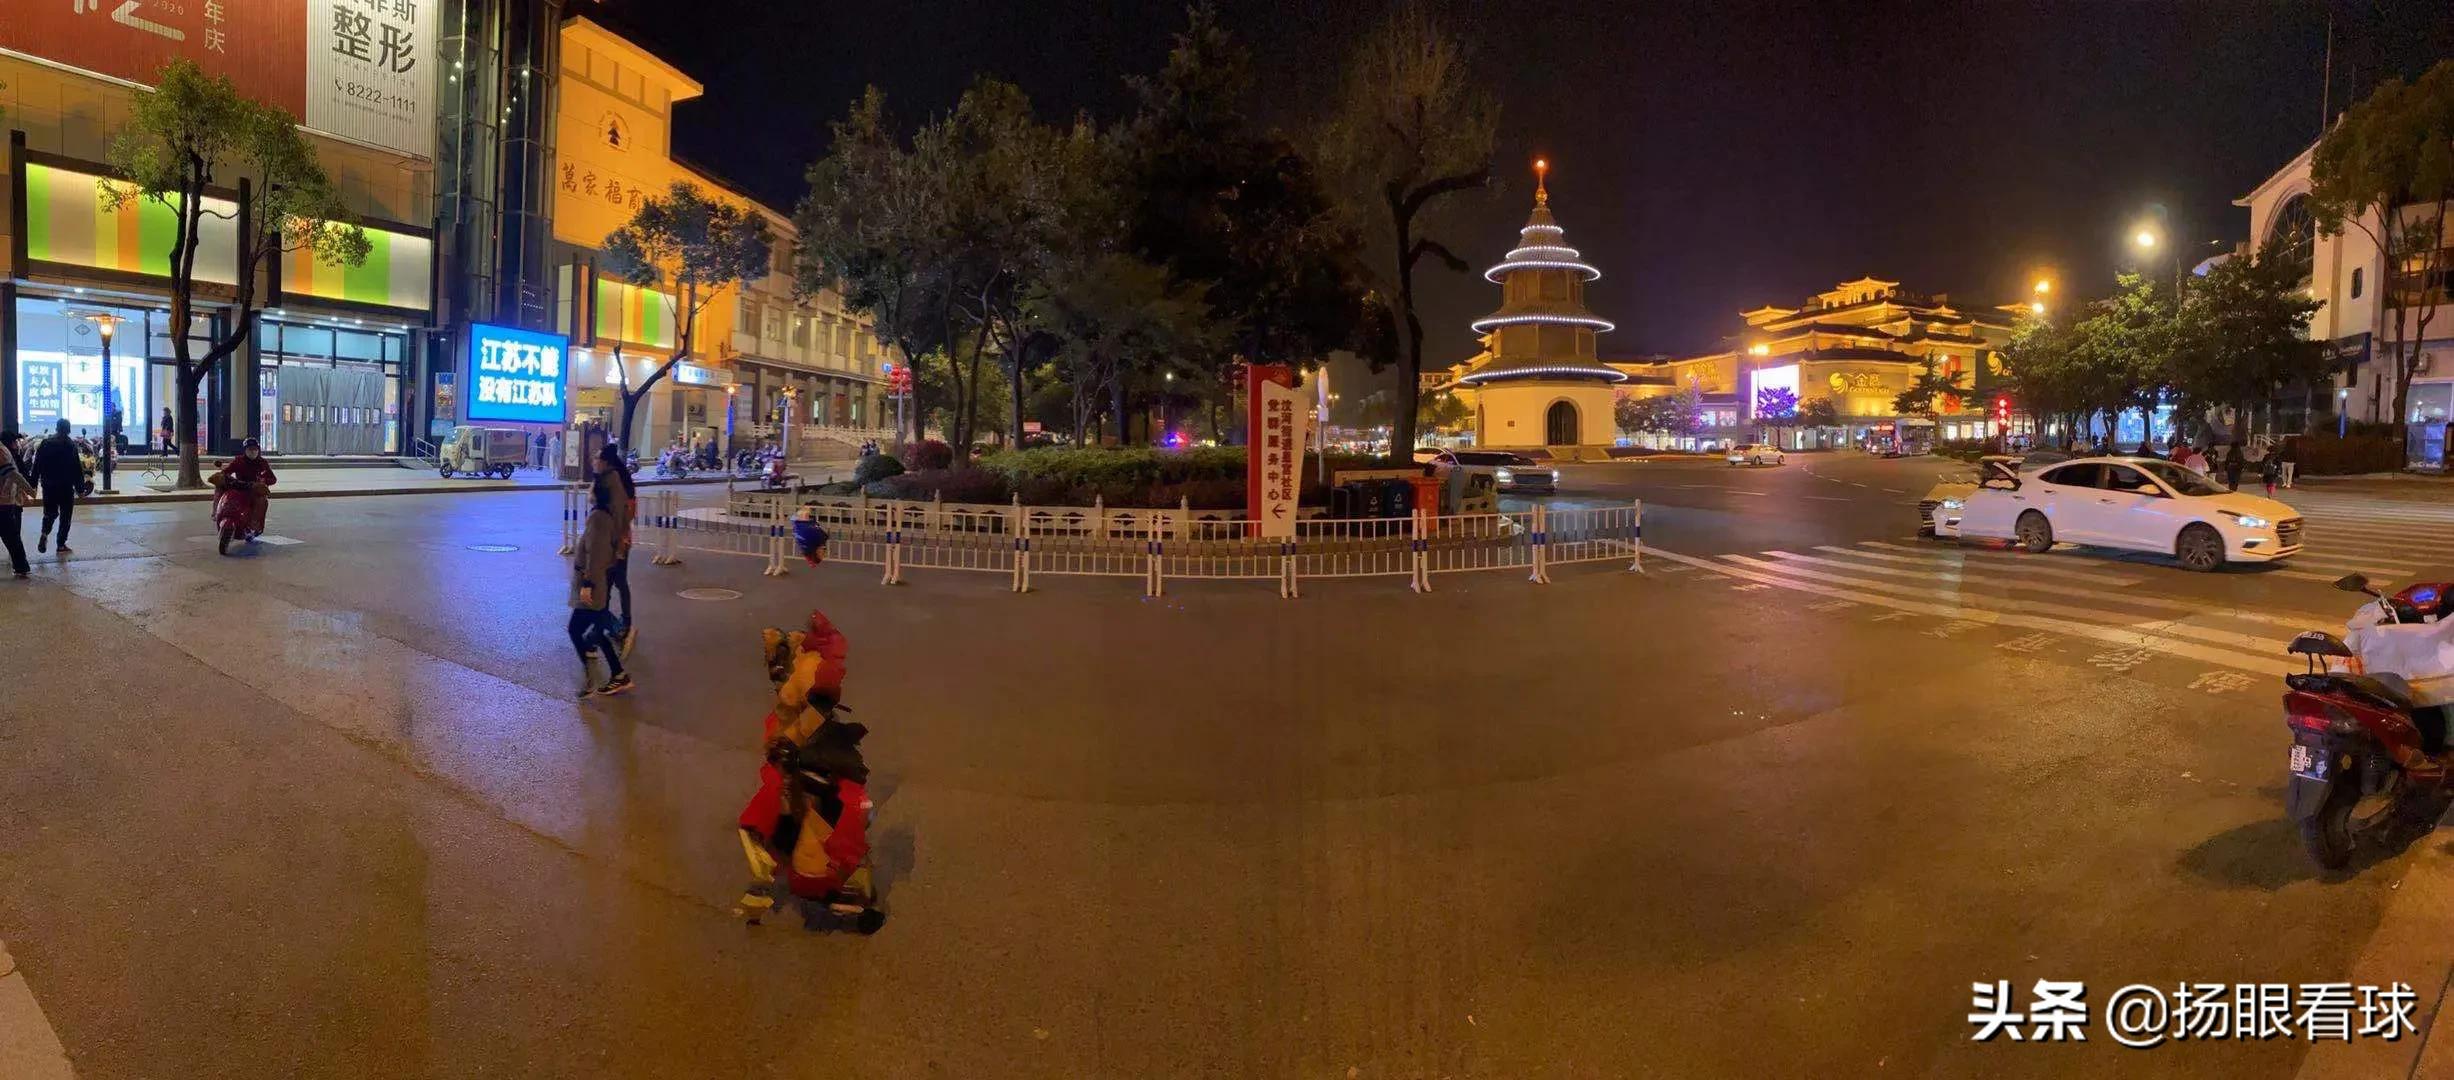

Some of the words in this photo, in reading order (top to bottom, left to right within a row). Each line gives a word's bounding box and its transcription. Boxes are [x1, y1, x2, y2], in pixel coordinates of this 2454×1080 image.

[332, 5, 416, 73] 整形
[1267, 399, 1280, 501] 党群服务中心
